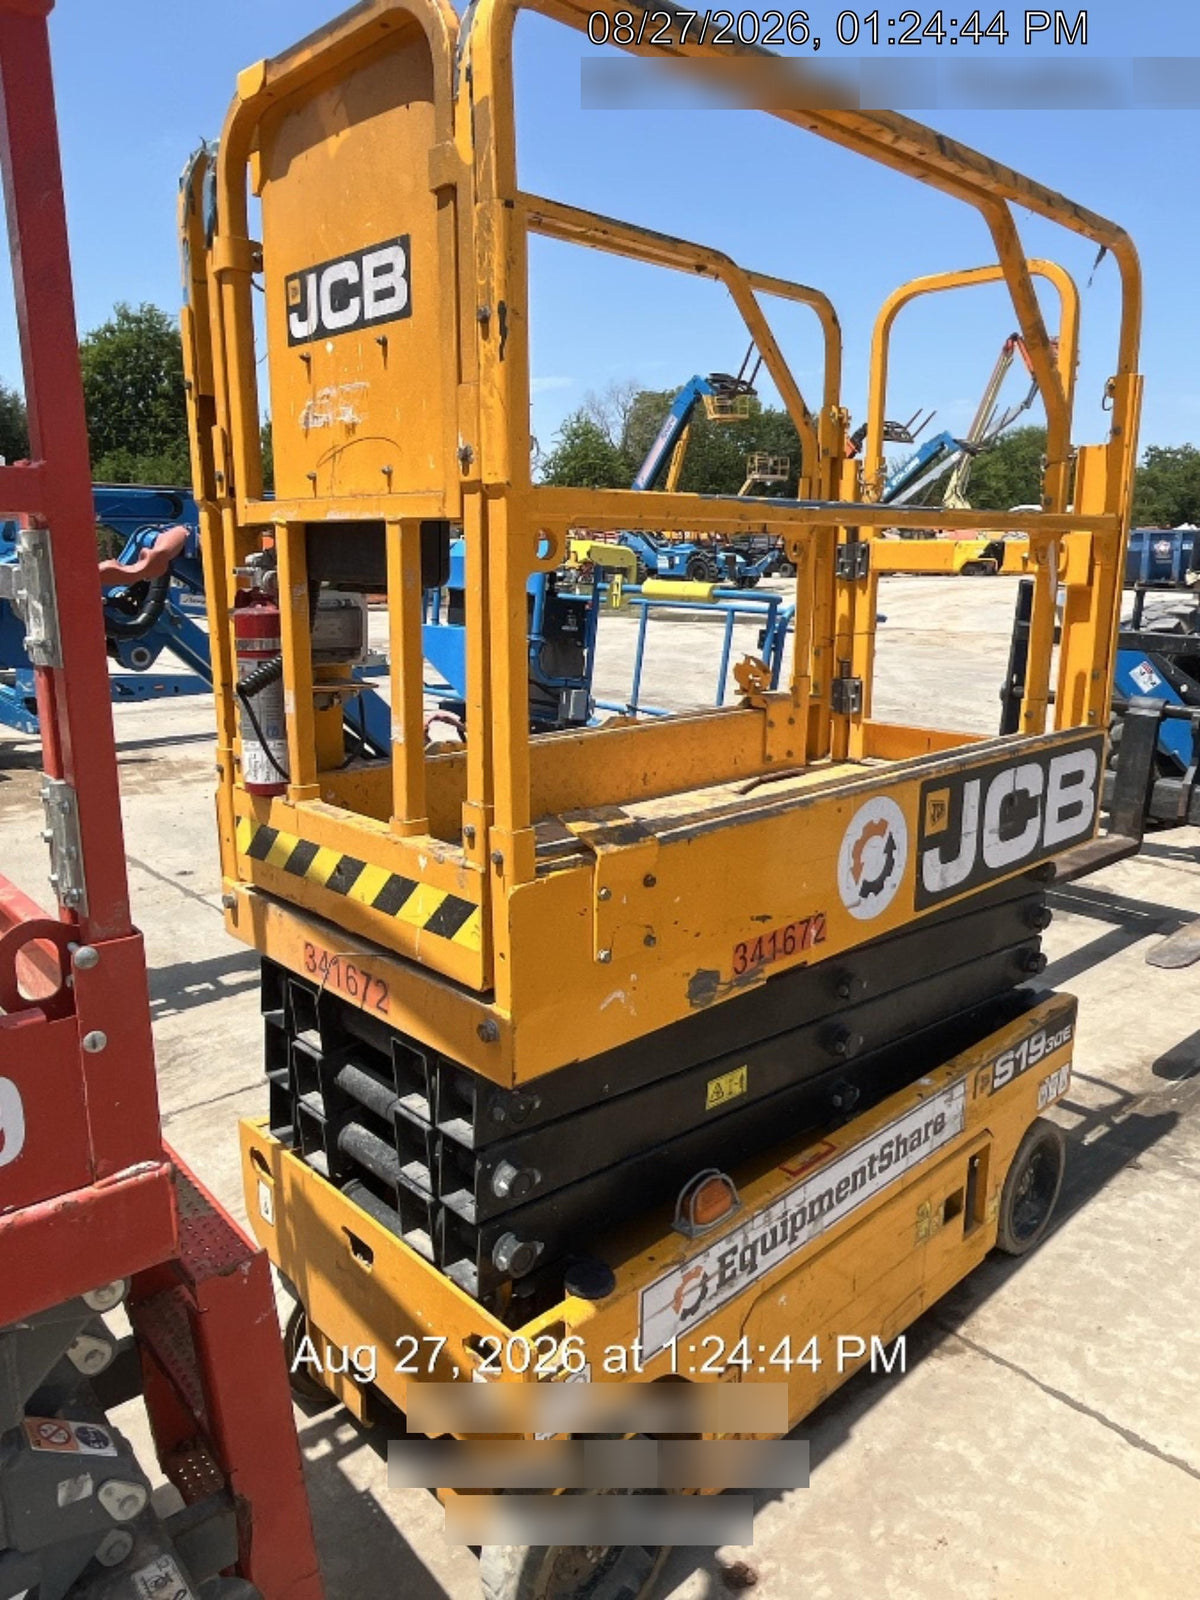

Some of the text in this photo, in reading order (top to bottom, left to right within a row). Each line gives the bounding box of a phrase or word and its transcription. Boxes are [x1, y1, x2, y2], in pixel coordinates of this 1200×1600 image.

[289, 245, 408, 339] JCB
[921, 747, 1098, 893] JCB
[303, 942, 390, 1015] 341672
[732, 912, 826, 975] 341672
[716, 1111, 947, 1291] EquipmentShare
